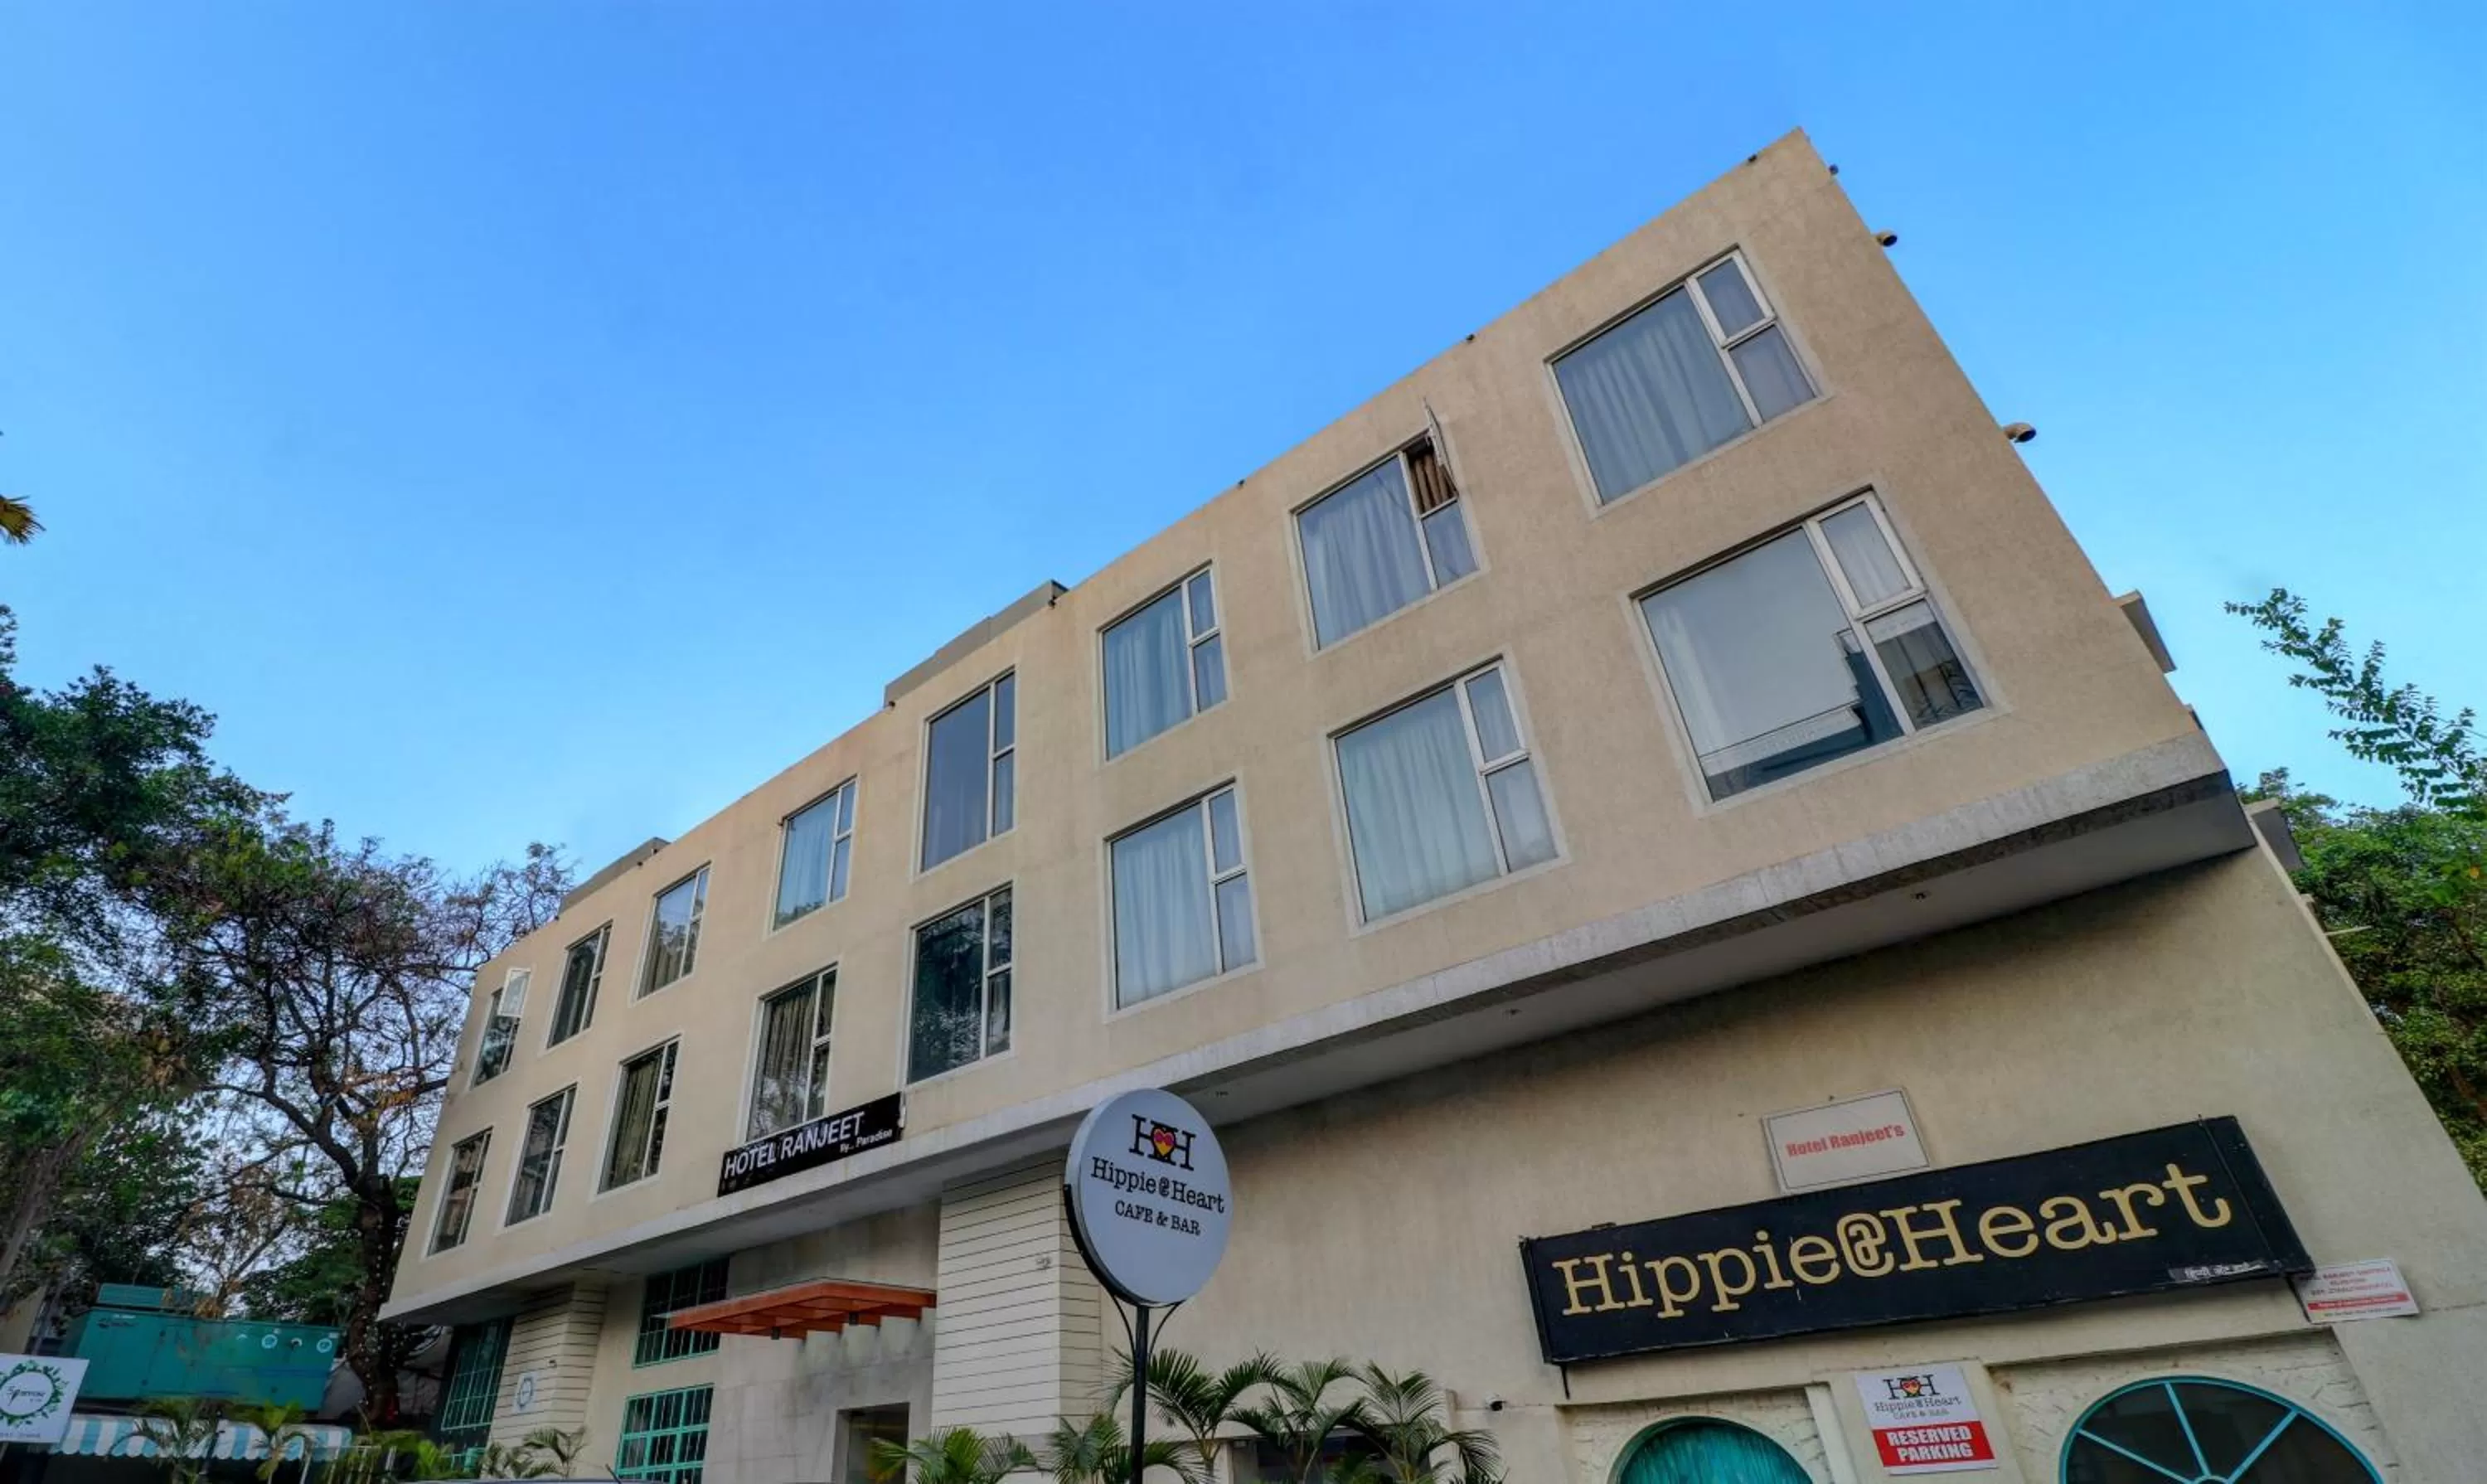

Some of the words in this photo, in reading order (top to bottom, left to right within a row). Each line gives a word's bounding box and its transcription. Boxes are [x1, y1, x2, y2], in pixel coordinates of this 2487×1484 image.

[724, 1143, 777, 1179] HOTEL
[781, 1111, 865, 1160] RANJEET
[1785, 1137, 1829, 1157] Hotel
[1828, 1124, 1905, 1149] Ranjeet's
[1090, 1157, 1225, 1214] Hippie@Heart
[1115, 1200, 1153, 1224] CAFE
[1156, 1211, 1169, 1225] &
[1171, 1215, 1201, 1235] BAR
[1551, 1162, 2232, 1318] Hippie@Heart
[1886, 1425, 1973, 1447] RESERVED
[1896, 1443, 1975, 1462] PARKING
